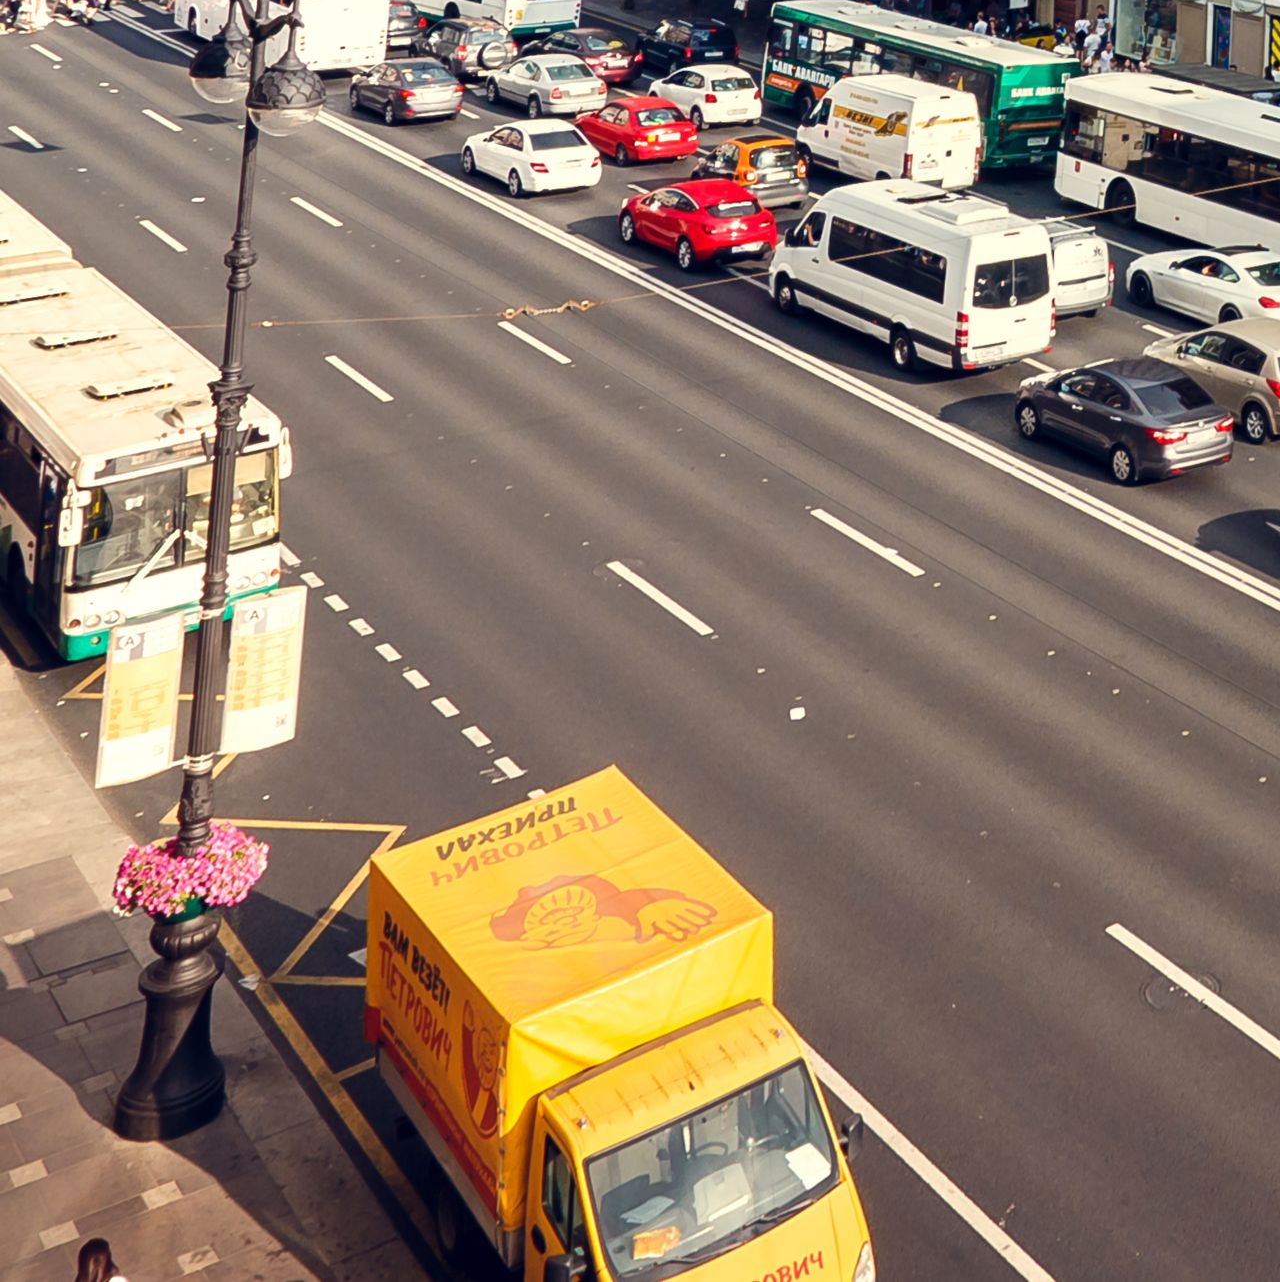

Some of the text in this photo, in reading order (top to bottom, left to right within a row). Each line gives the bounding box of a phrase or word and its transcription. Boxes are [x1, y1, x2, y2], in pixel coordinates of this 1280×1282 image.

[772, 59, 794, 76] БАНК
[1011, 86, 1064, 98] БАНК АВАНГА
[430, 807, 623, 887] ПЕТРОВИЧ
[435, 796, 577, 861] ПРИЕХАЛ
[384, 910, 452, 1016] ВАМ ВЕЗЁТ!
[379, 940, 452, 1071] ПЕТРОВИЧ
[752, 1250, 824, 1282] ОВИЧ
